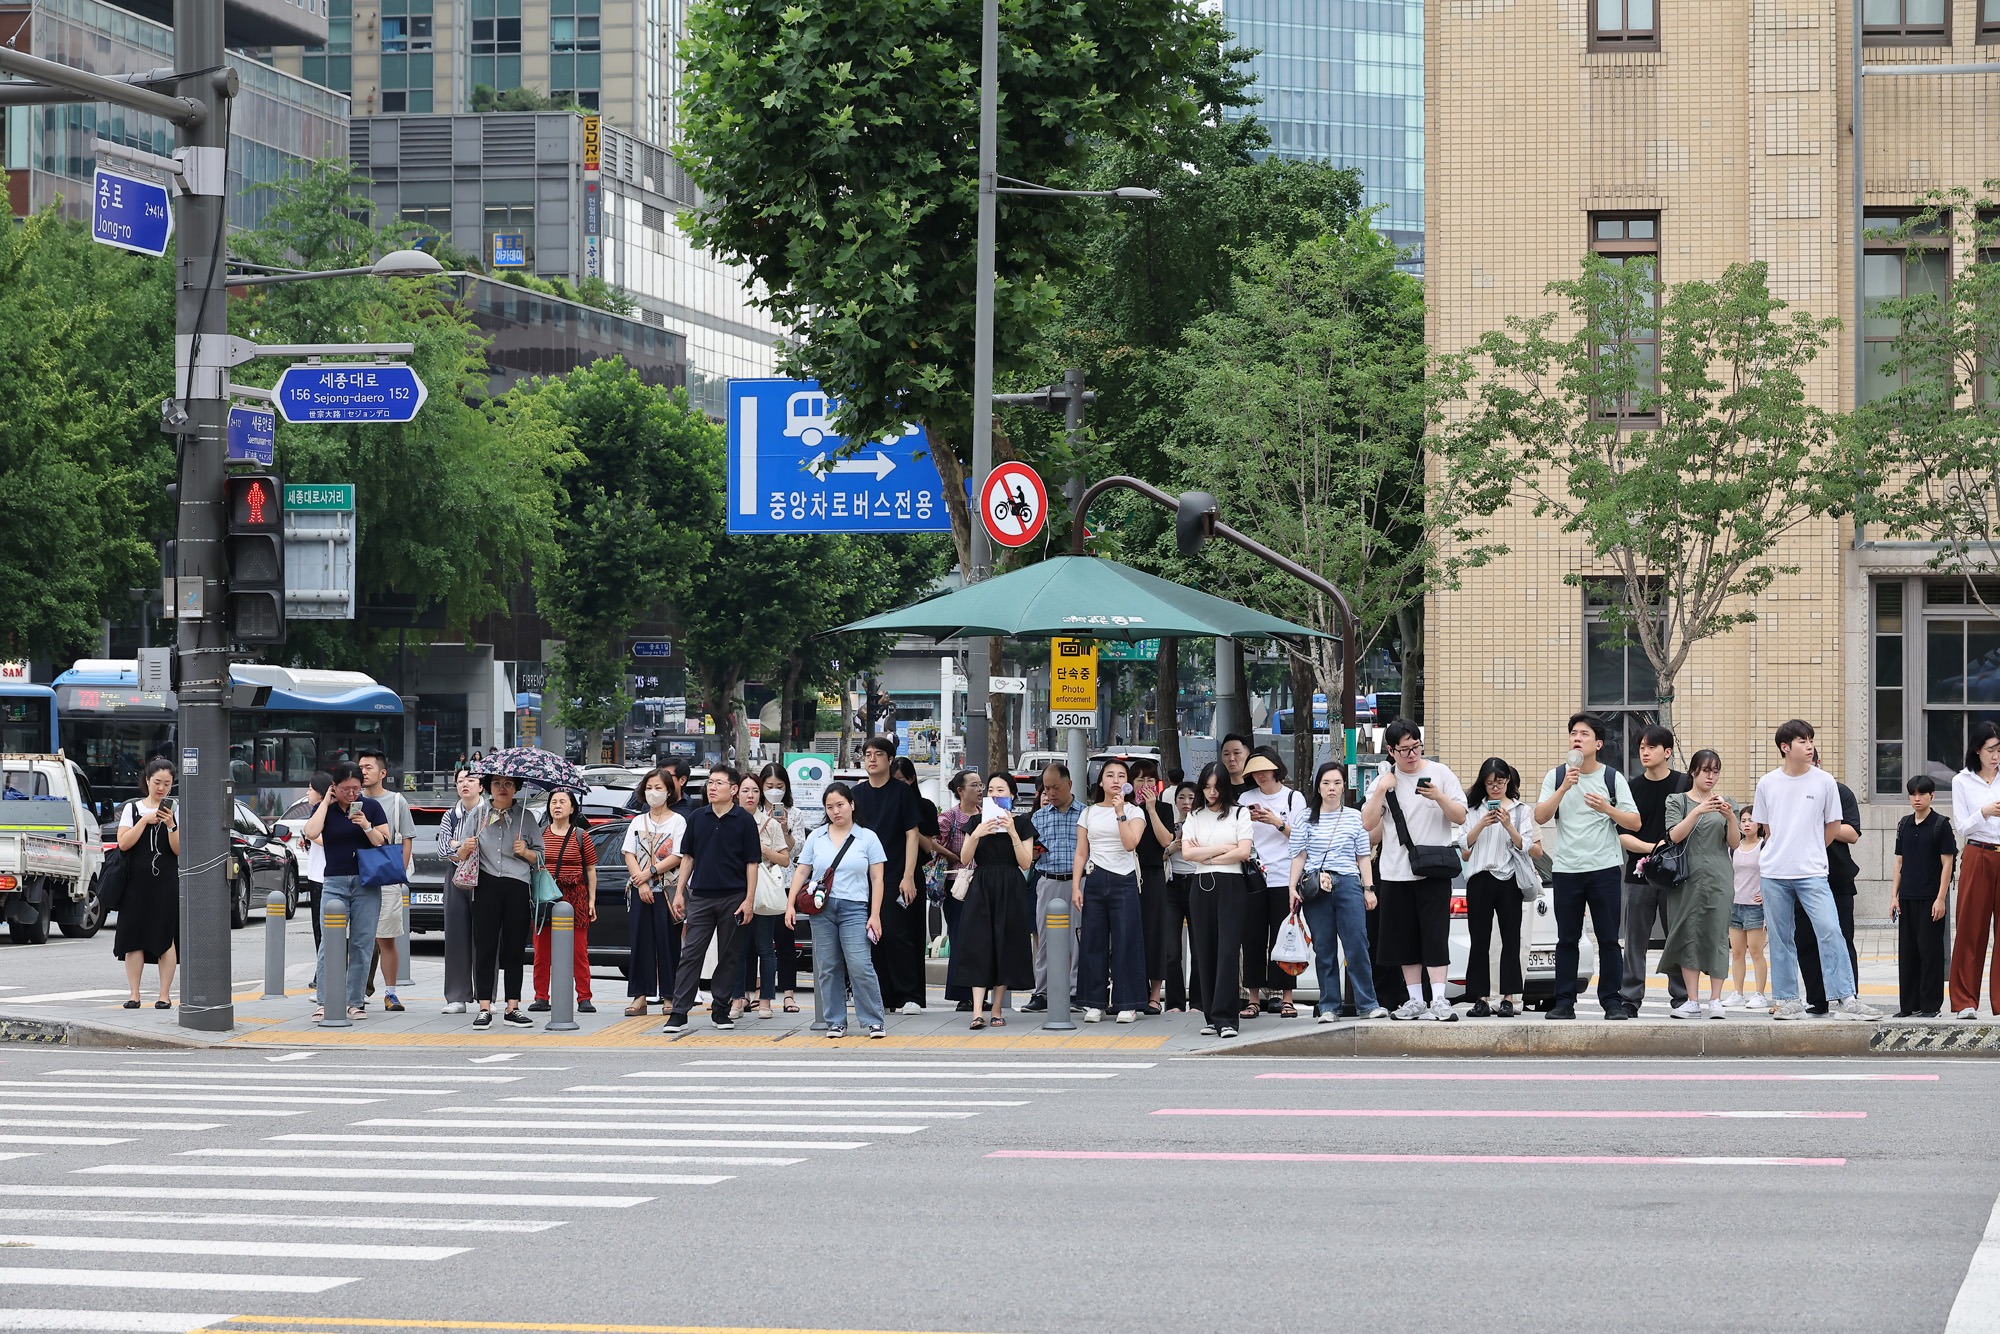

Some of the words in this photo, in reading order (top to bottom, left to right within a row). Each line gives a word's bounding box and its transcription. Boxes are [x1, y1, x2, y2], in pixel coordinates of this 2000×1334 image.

[586, 120, 598, 155] GDR
[99, 179, 123, 208] 종로
[97, 213, 132, 240] Jong-ro
[495, 249, 523, 262] 아카데미
[318, 372, 379, 390] 세종대로
[289, 388, 311, 401] 156
[313, 392, 385, 405] Sejong-daero
[388, 387, 410, 400] 152
[308, 409, 342, 419] 世宗大路
[347, 409, 390, 419] セジョンデロ
[251, 415, 273, 433] 새문안로
[288, 490, 344, 504] 세종대로사거리
[769, 489, 934, 521] 중앙차로버스전용
[1057, 667, 1090, 680] 단속중
[522, 675, 545, 687] FIBRENO
[1061, 684, 1085, 694] Photo
[1055, 695, 1091, 704] enforcement
[1056, 713, 1091, 726] 250m
